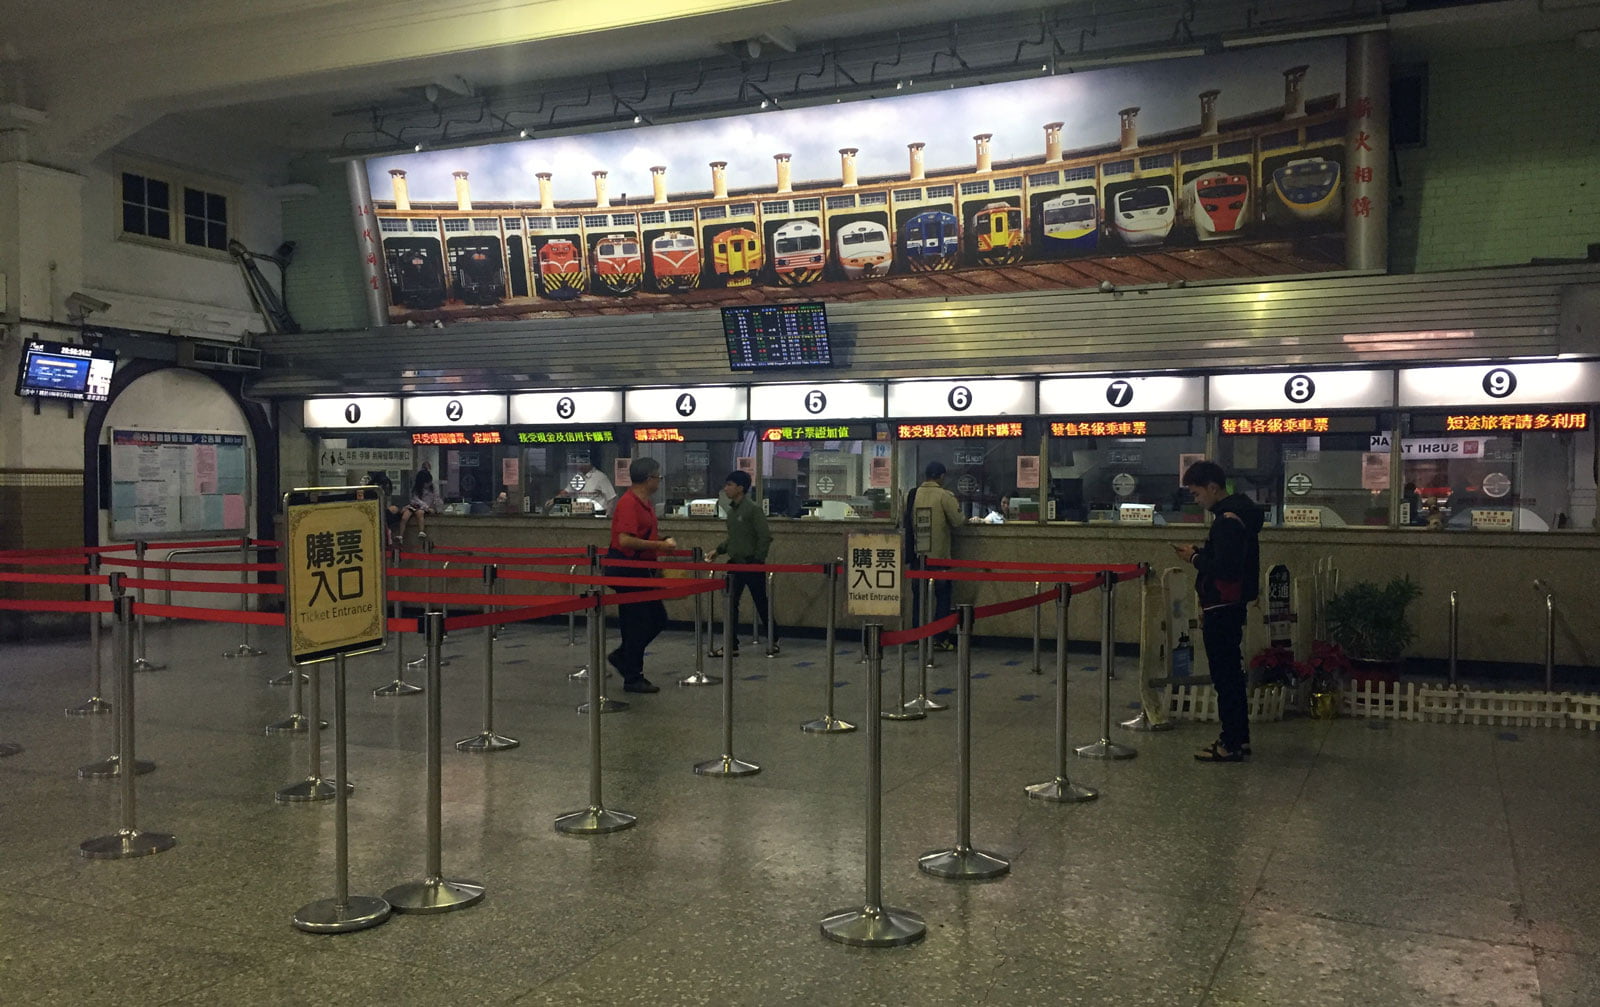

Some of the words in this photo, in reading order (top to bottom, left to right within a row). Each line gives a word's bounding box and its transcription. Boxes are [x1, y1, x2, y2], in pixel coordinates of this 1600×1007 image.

[897, 423, 1023, 438] 接受現金及信用卡購票
[1050, 421, 1147, 436] 發售各級乘車票
[1221, 417, 1329, 433] 發售各級乘車票
[1446, 412, 1587, 431] 短途旅客請多利用
[518, 430, 614, 443] 接受現金及信用卡購票
[306, 529, 364, 570] 購票
[852, 547, 896, 569] 購票
[308, 566, 364, 607] 入口
[852, 569, 895, 589] 入口
[849, 592, 869, 601] Ticket
[870, 592, 899, 602] Entrance
[300, 609, 330, 623] Ticket
[332, 604, 374, 618] Entrance
